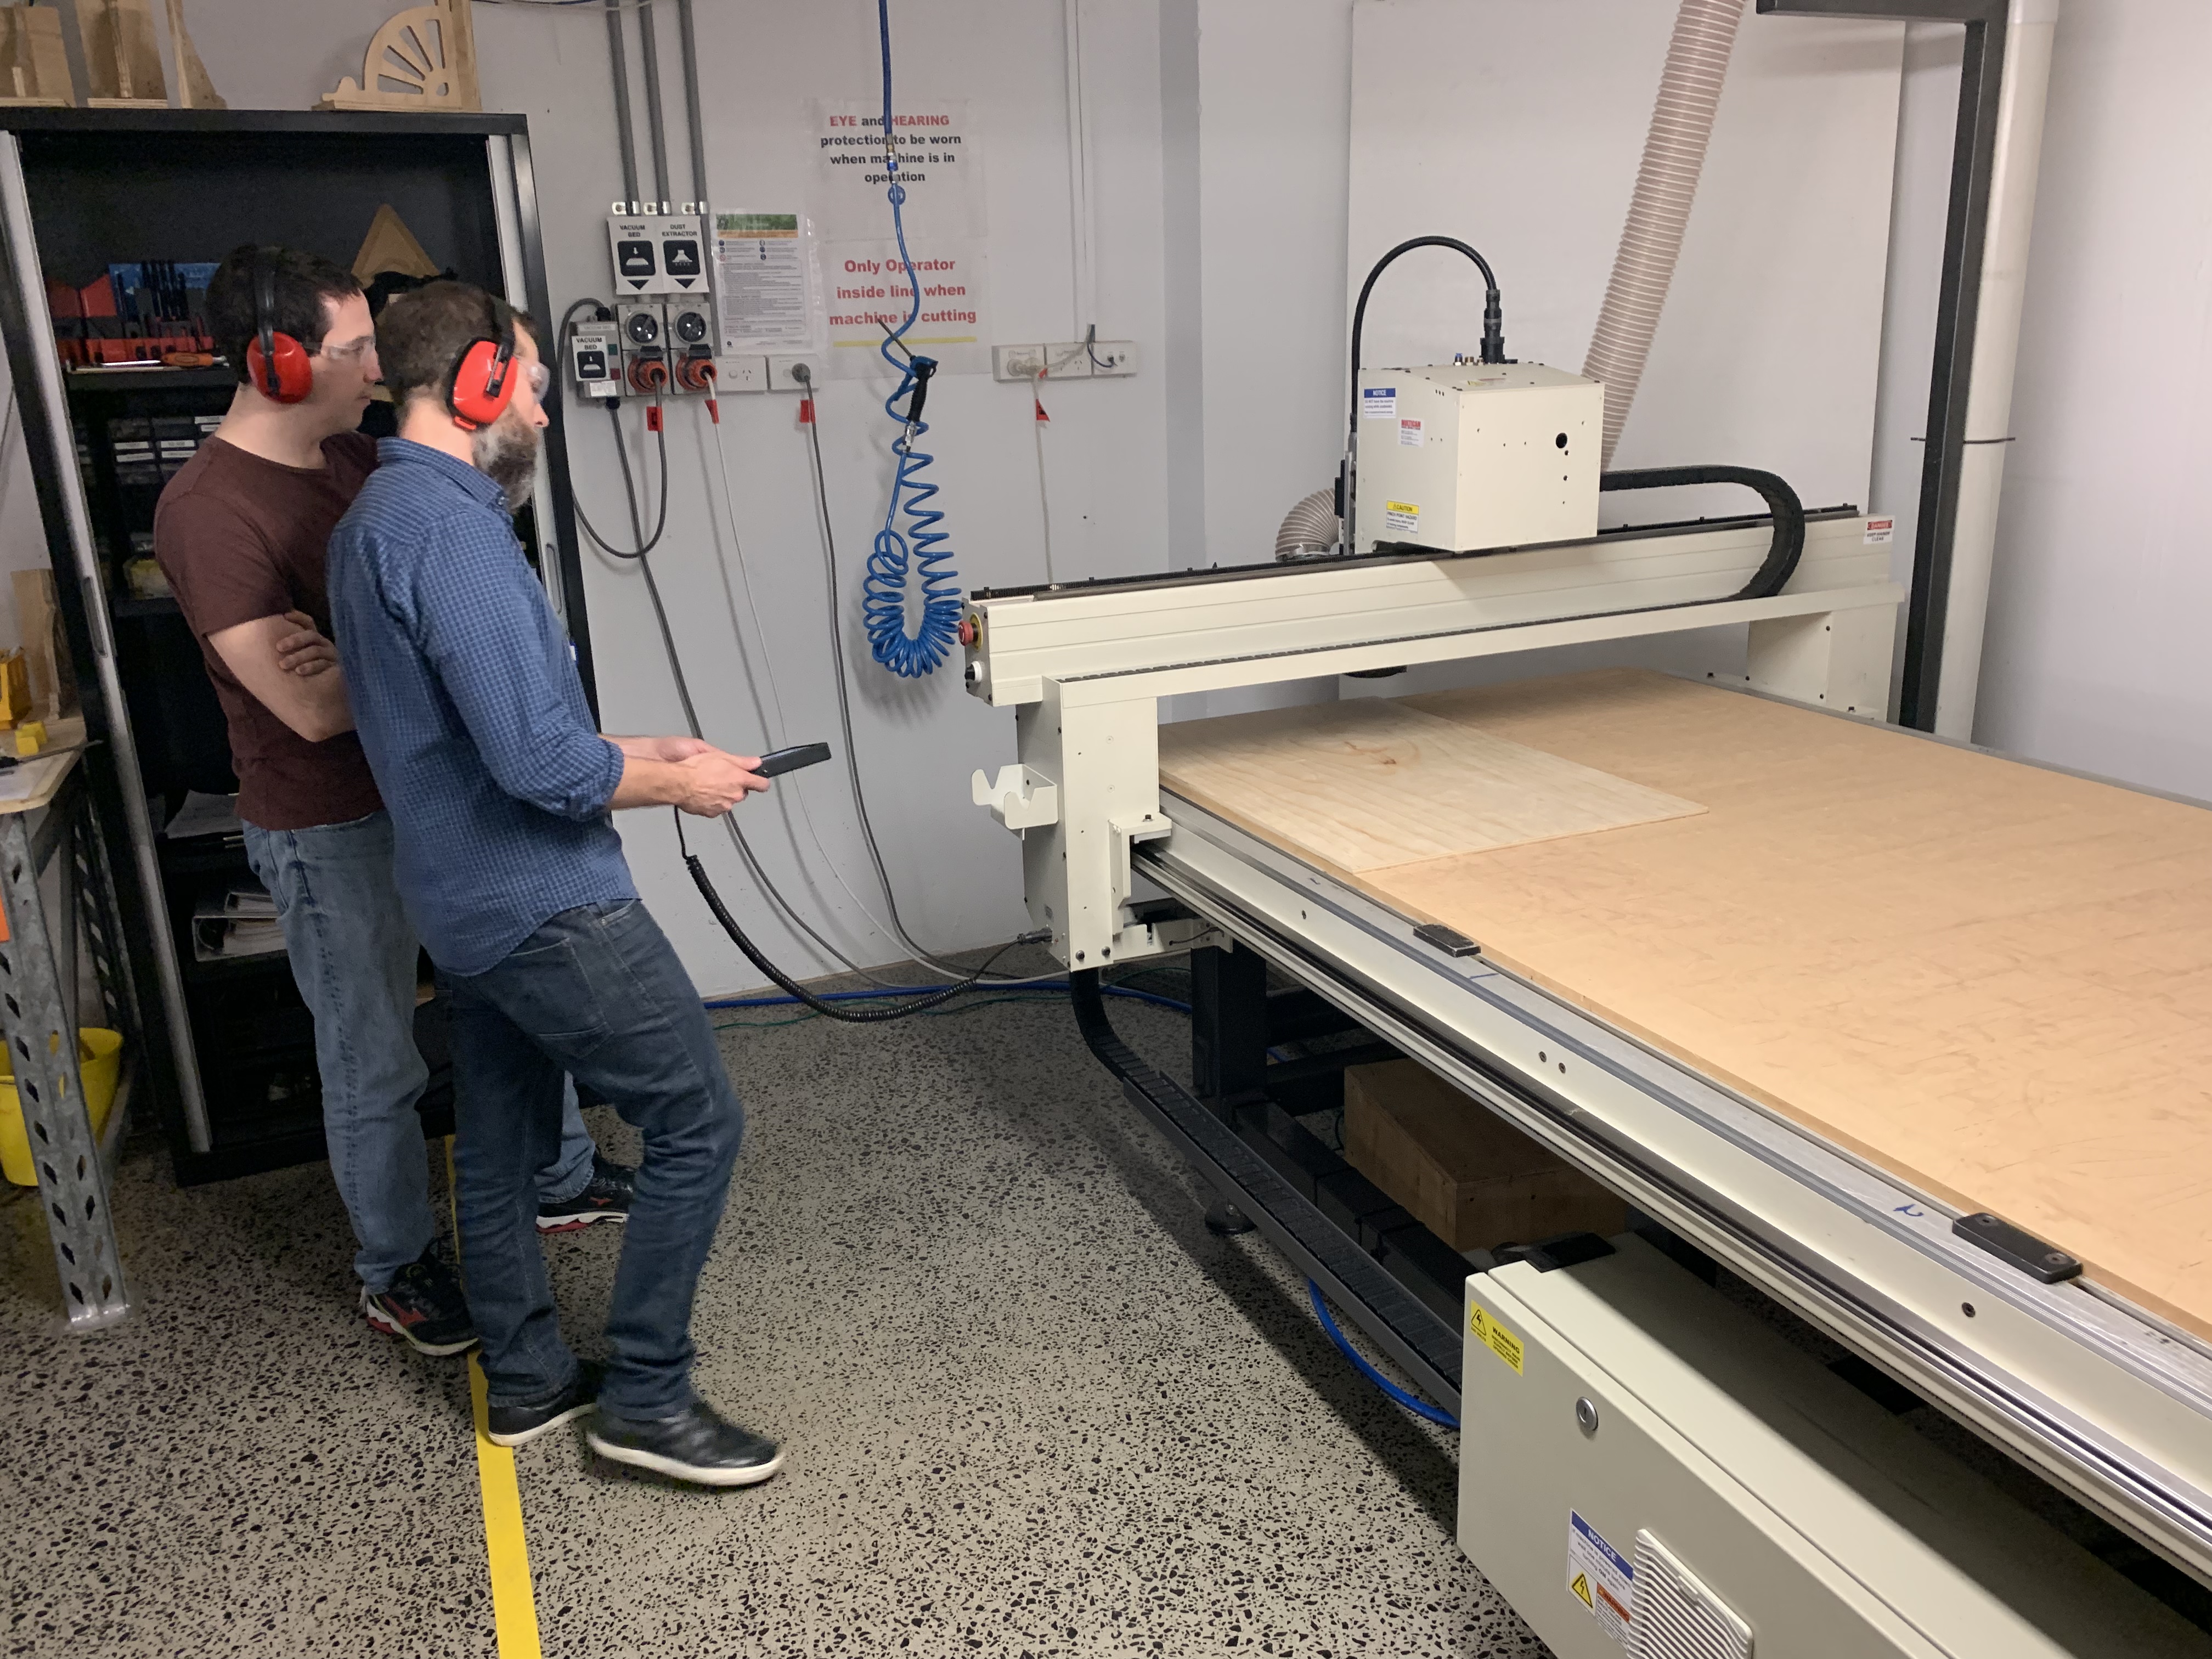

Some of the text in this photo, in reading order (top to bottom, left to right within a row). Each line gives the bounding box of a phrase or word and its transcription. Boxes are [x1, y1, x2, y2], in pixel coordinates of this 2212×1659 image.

[830, 115, 950, 127] EYE and HEARING
[894, 134, 906, 144] to
[910, 134, 926, 144] be
[929, 136, 961, 144] worn
[830, 152, 955, 165] when mahine is in
[865, 171, 926, 184] opetion
[844, 258, 956, 275] Only Operator
[837, 286, 885, 299] inside
[924, 284, 966, 296] when
[829, 309, 977, 325] machine i cutting
[1492, 1326, 1520, 1355] WARNING
[1588, 1528, 1617, 1563] NOTICE
[1576, 1533, 1594, 1551] machine
[1599, 1555, 1618, 1576] powered
[1578, 1542, 1587, 1552] wait
[1587, 1550, 1595, 1560] one
[1595, 1559, 1611, 1576] minute
[1611, 1573, 1626, 1590] before
[1582, 1553, 1598, 1571] turning
[1599, 1568, 1606, 1578] ON
[1604, 1591, 1629, 1623] WARNING
